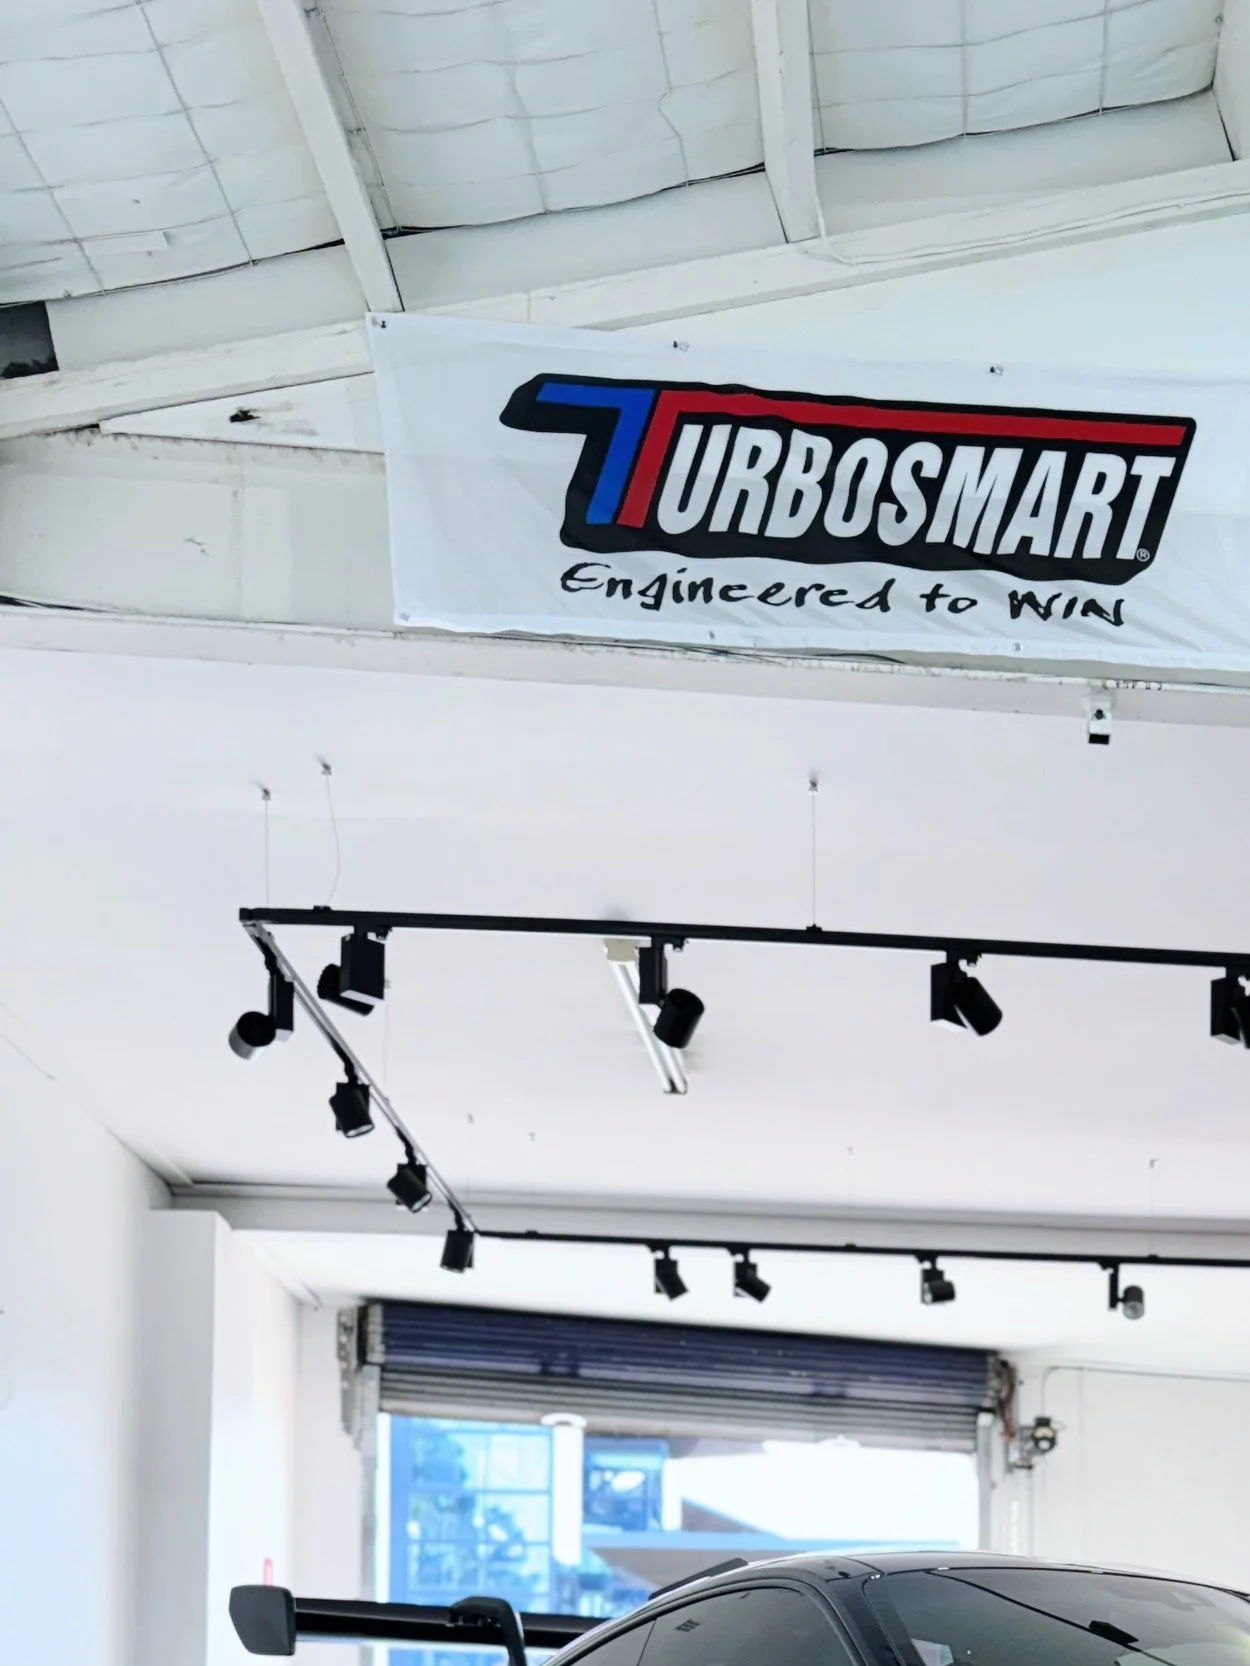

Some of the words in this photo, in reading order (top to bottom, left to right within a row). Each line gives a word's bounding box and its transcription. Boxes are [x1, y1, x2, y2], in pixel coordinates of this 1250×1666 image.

[535, 382, 1183, 562] TURBOSMART
[560, 562, 892, 612] Engineered
[919, 583, 978, 614] to
[1008, 589, 1125, 627] WIN
